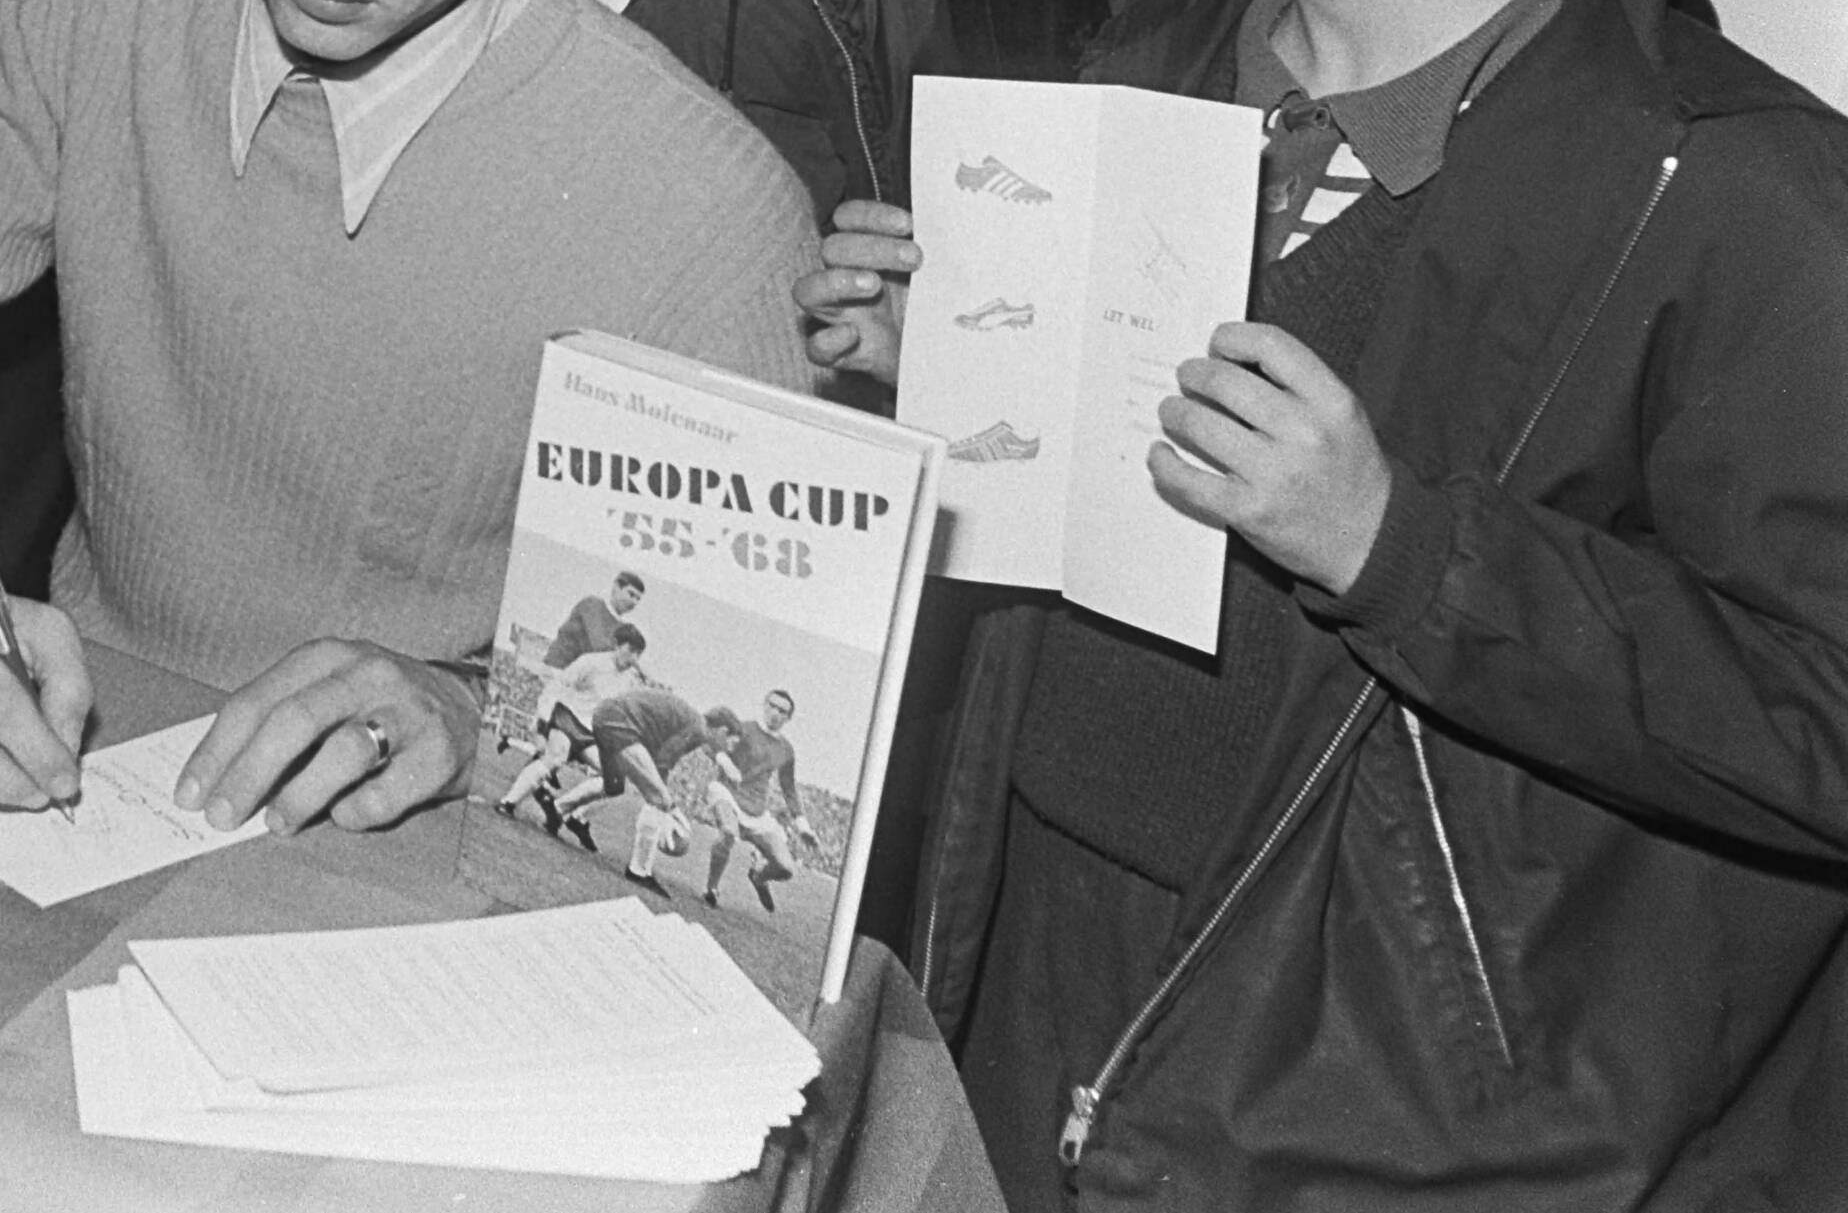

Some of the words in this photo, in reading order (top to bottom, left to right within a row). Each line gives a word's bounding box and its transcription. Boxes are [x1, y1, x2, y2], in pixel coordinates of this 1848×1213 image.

[563, 370, 620, 410] Hans
[623, 391, 739, 446] Molenaar
[535, 441, 754, 514] EUROPA
[768, 480, 893, 533] CUP
